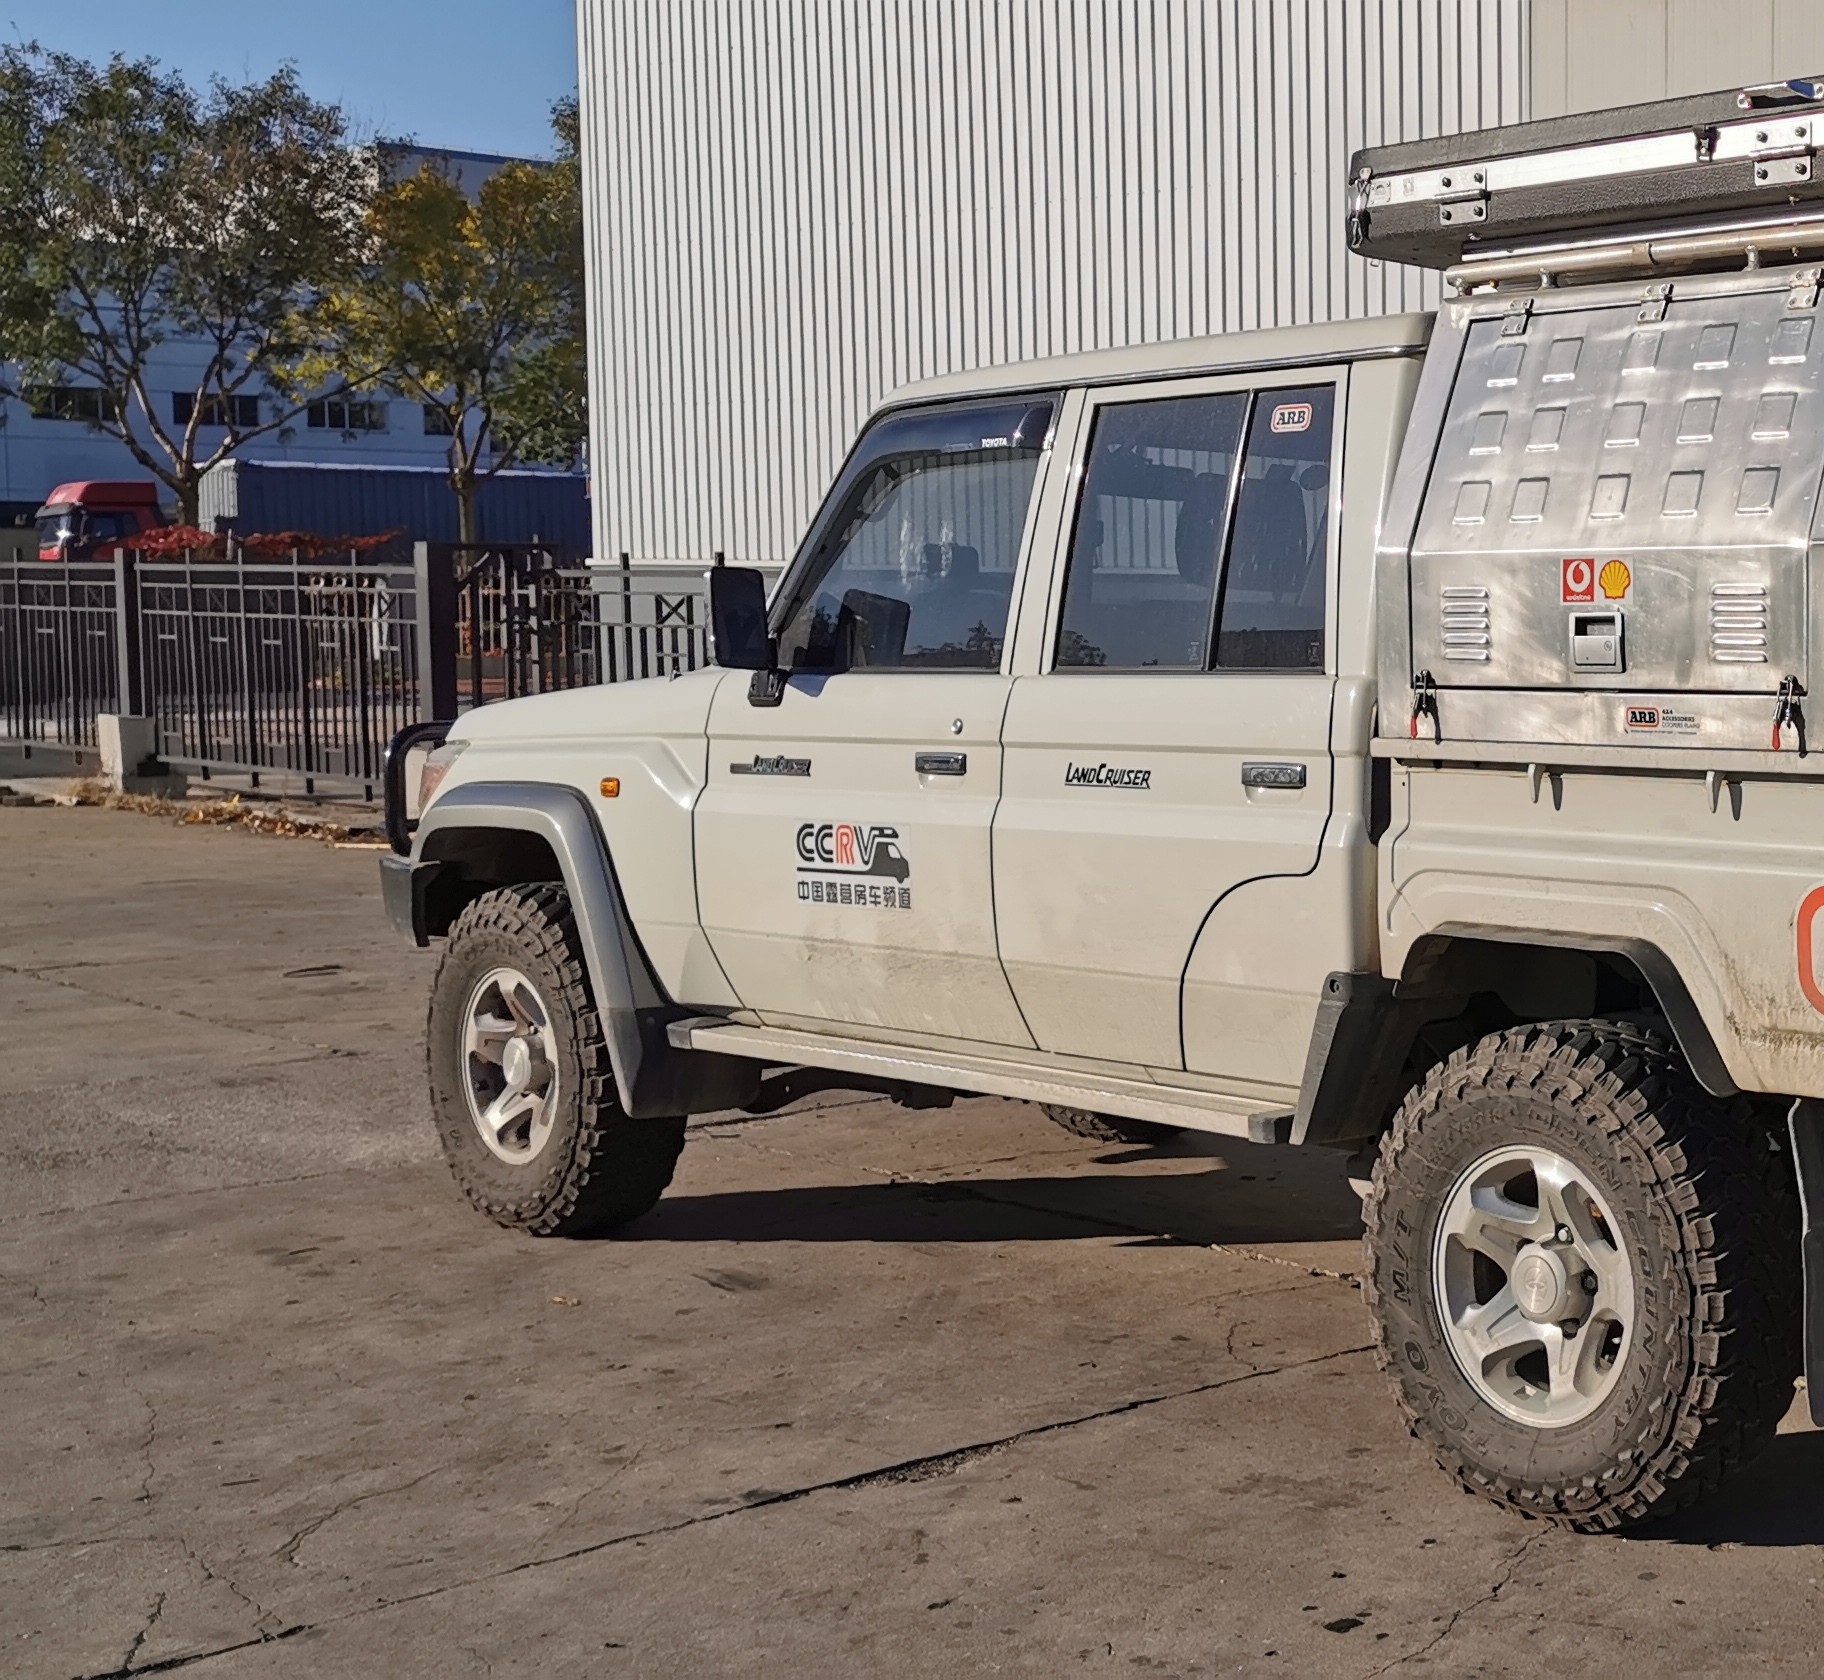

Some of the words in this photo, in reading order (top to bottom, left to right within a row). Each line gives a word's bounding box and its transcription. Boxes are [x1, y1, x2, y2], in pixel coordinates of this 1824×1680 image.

[1276, 410, 1306, 425] ARB
[981, 437, 1008, 448] TOYOTA
[1630, 710, 1656, 724] ARB
[797, 823, 882, 866] CCRV
[797, 880, 911, 910] 中国露营房车频道
